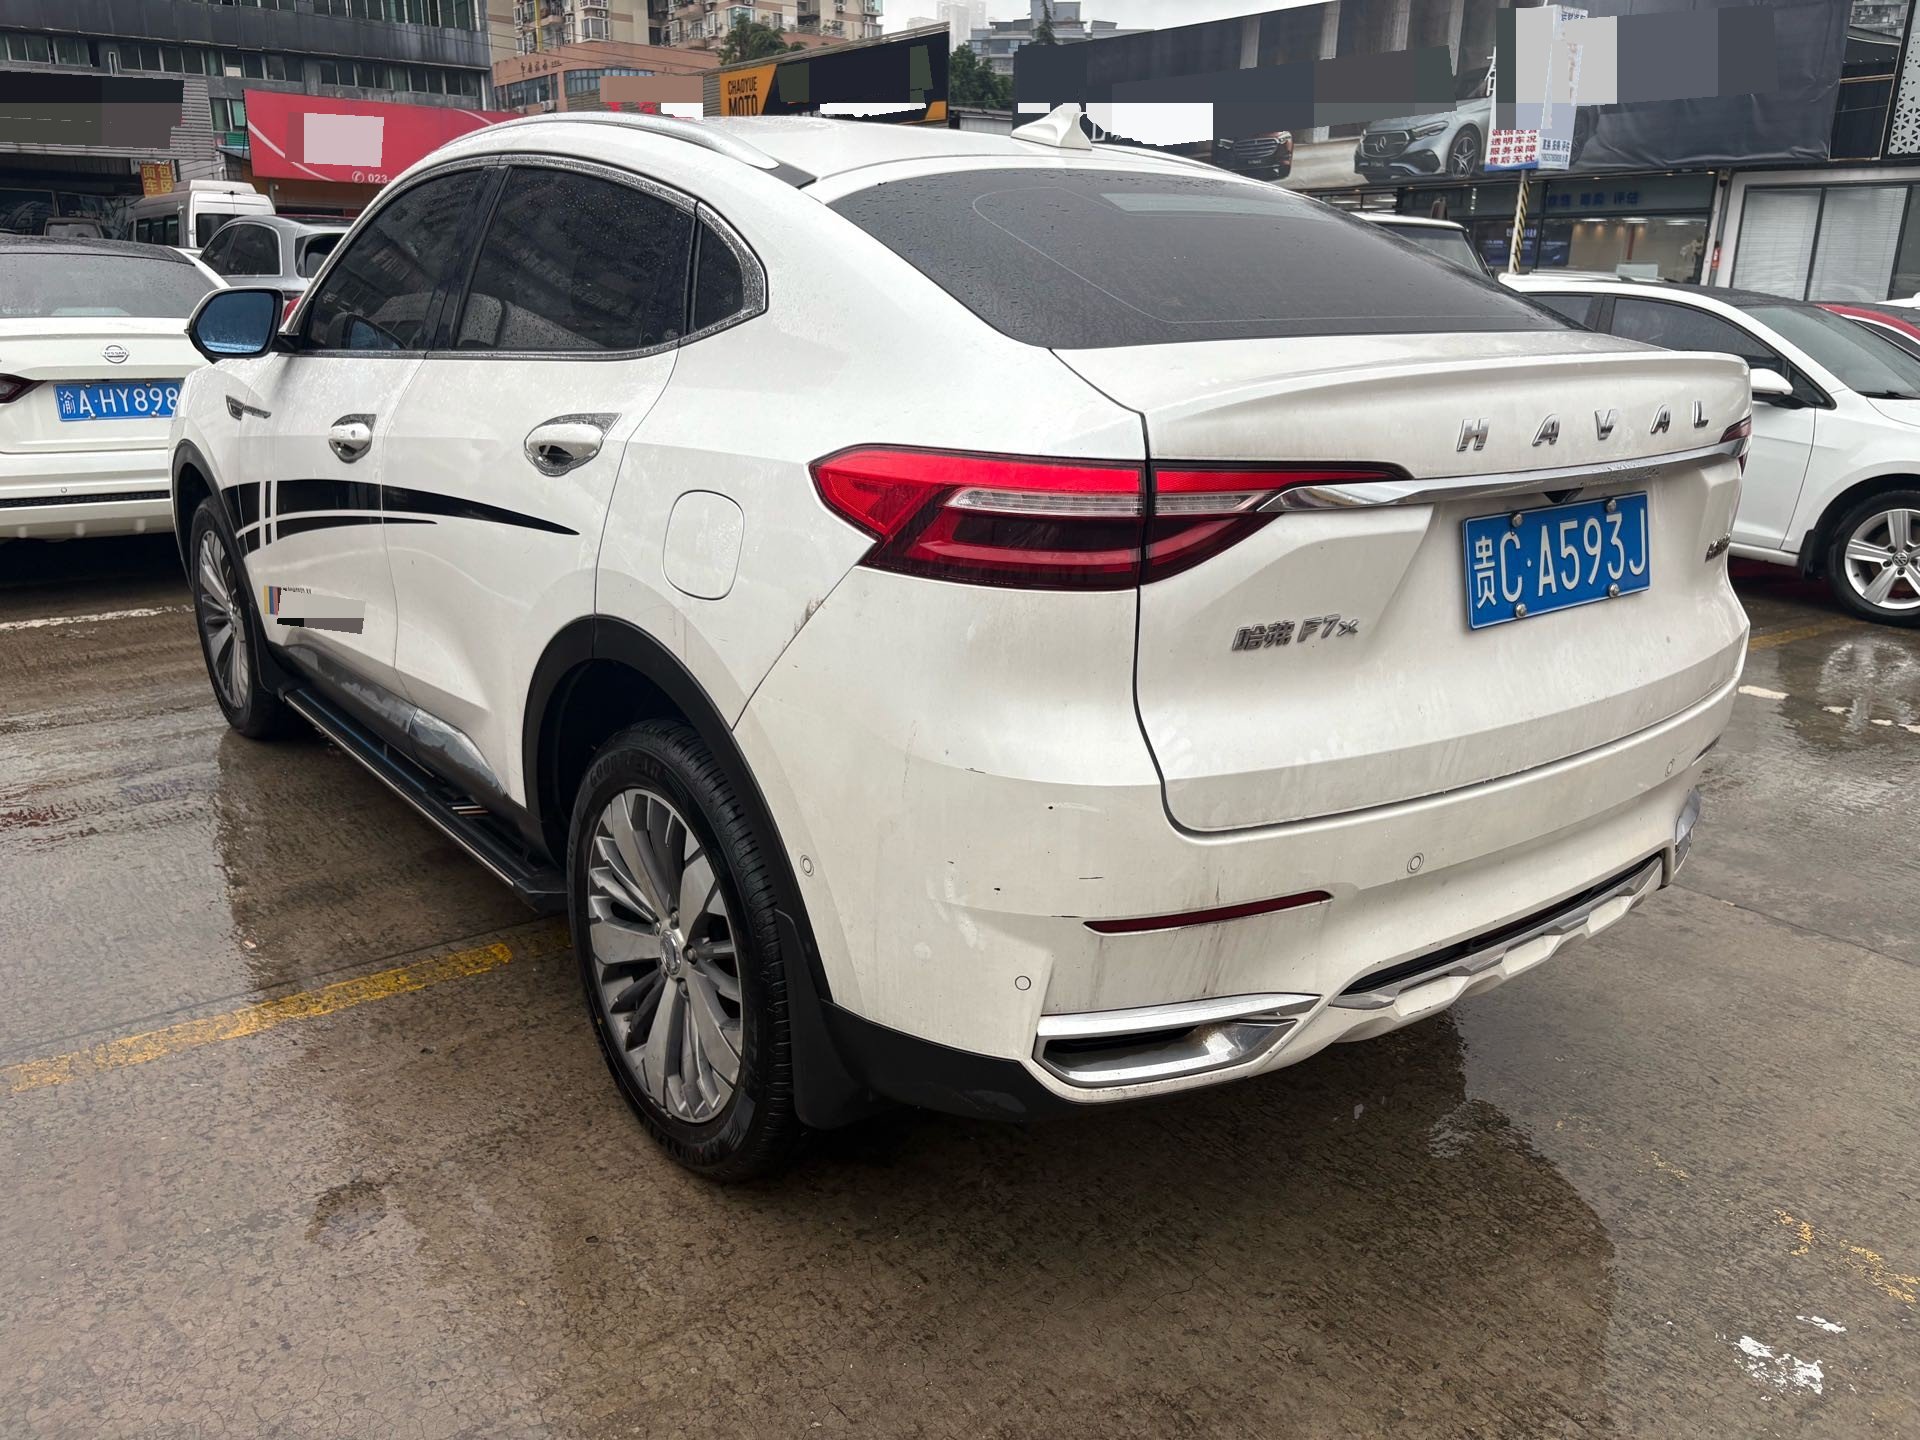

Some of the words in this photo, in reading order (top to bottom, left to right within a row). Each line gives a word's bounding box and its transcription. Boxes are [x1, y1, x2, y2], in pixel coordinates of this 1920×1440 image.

[728, 76, 757, 95] CHAOYUE
[728, 94, 758, 116] MOTO
[1490, 145, 1536, 155] 服务保障
[1491, 136, 1537, 146] 透明车况
[1489, 154, 1535, 165] 售后无忧
[143, 164, 172, 179] 面包
[1456, 400, 1709, 452] HAVAL
[1473, 507, 1647, 609] 贵C·A593J
[1232, 620, 1295, 651] 哈弗
